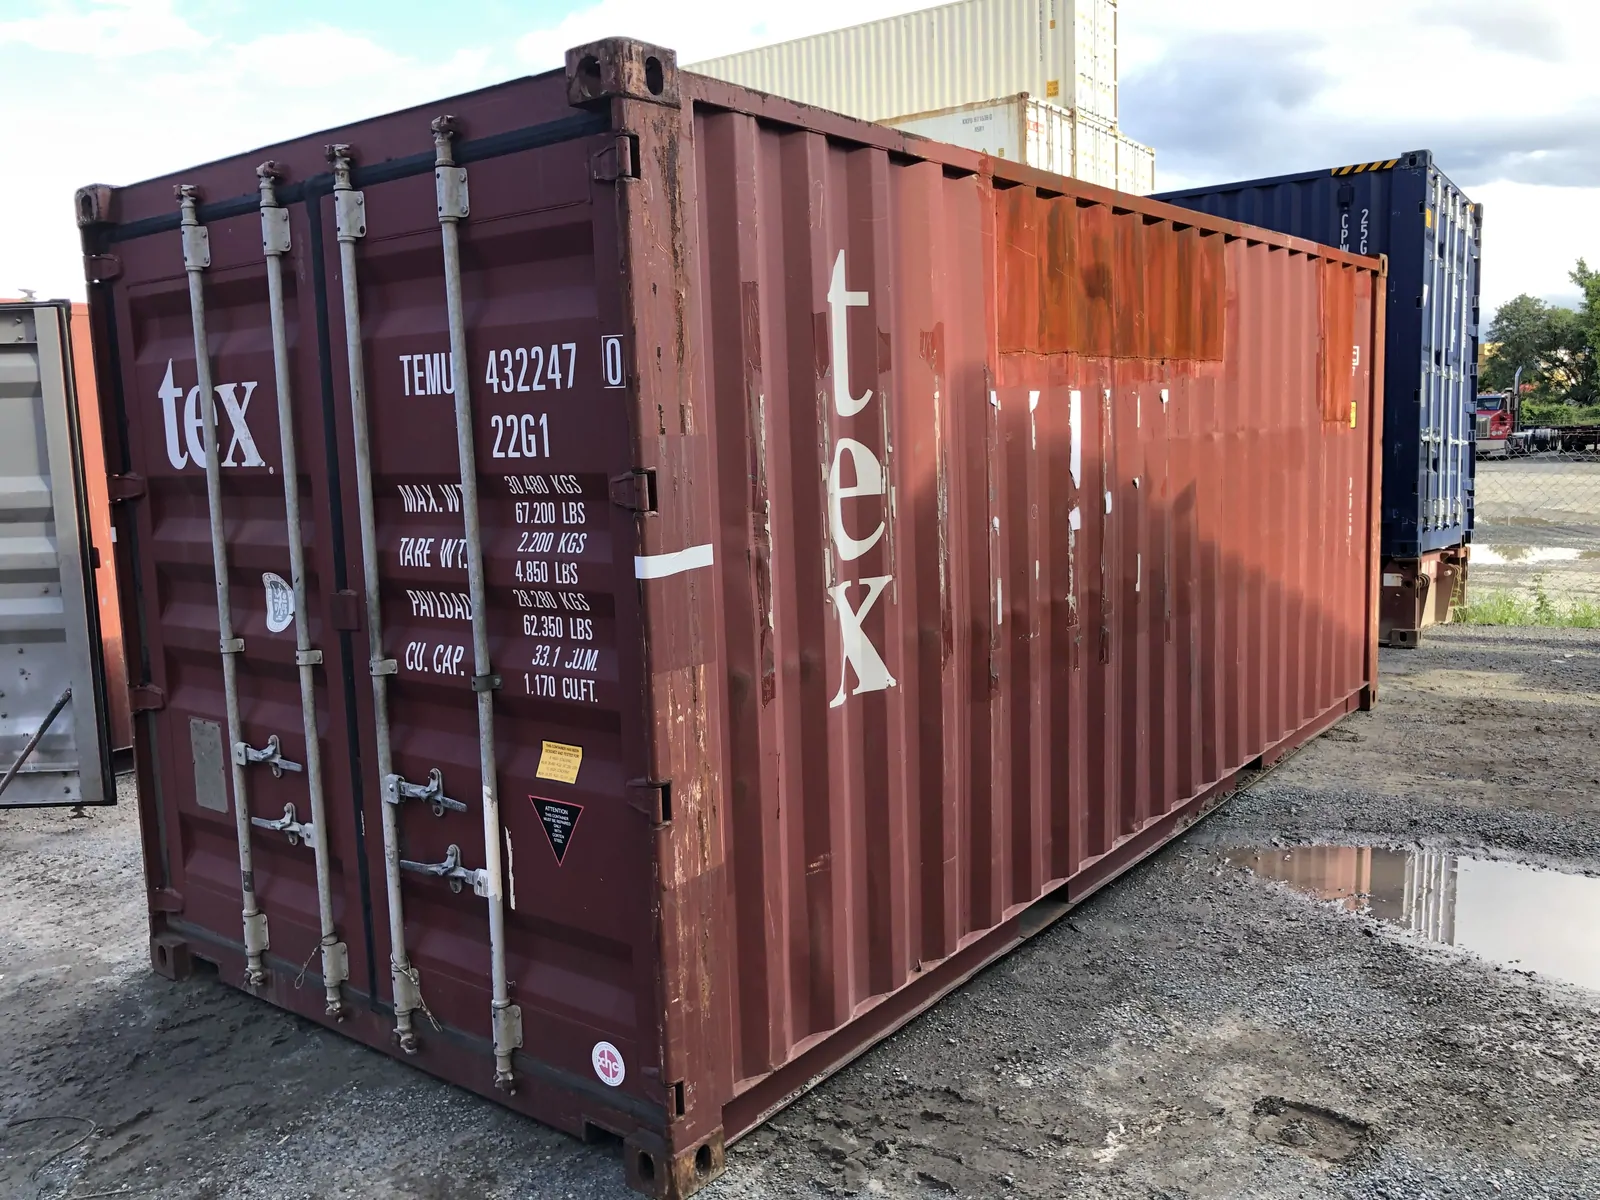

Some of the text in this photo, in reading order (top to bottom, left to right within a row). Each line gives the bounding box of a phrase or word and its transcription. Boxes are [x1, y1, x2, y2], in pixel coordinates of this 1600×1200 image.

[399, 337, 622, 396] TEMU 432247 0
[491, 413, 550, 459] 22G1
[504, 474, 582, 495] 30.480 KGS
[397, 484, 443, 513] MAX.
[515, 502, 586, 524] 67.200 LBS
[399, 537, 434, 568] TARE
[517, 531, 587, 554] 2.200 KGS
[515, 561, 578, 585] 4.850 LBS
[406, 589, 473, 620] PAYLOAD
[512, 589, 591, 611] 28.280 KGS
[523, 614, 593, 641] 62.350 LBS
[405, 641, 465, 676] CU. CAP.
[532, 645, 561, 668] 33.1
[523, 672, 556, 697] 1.170
